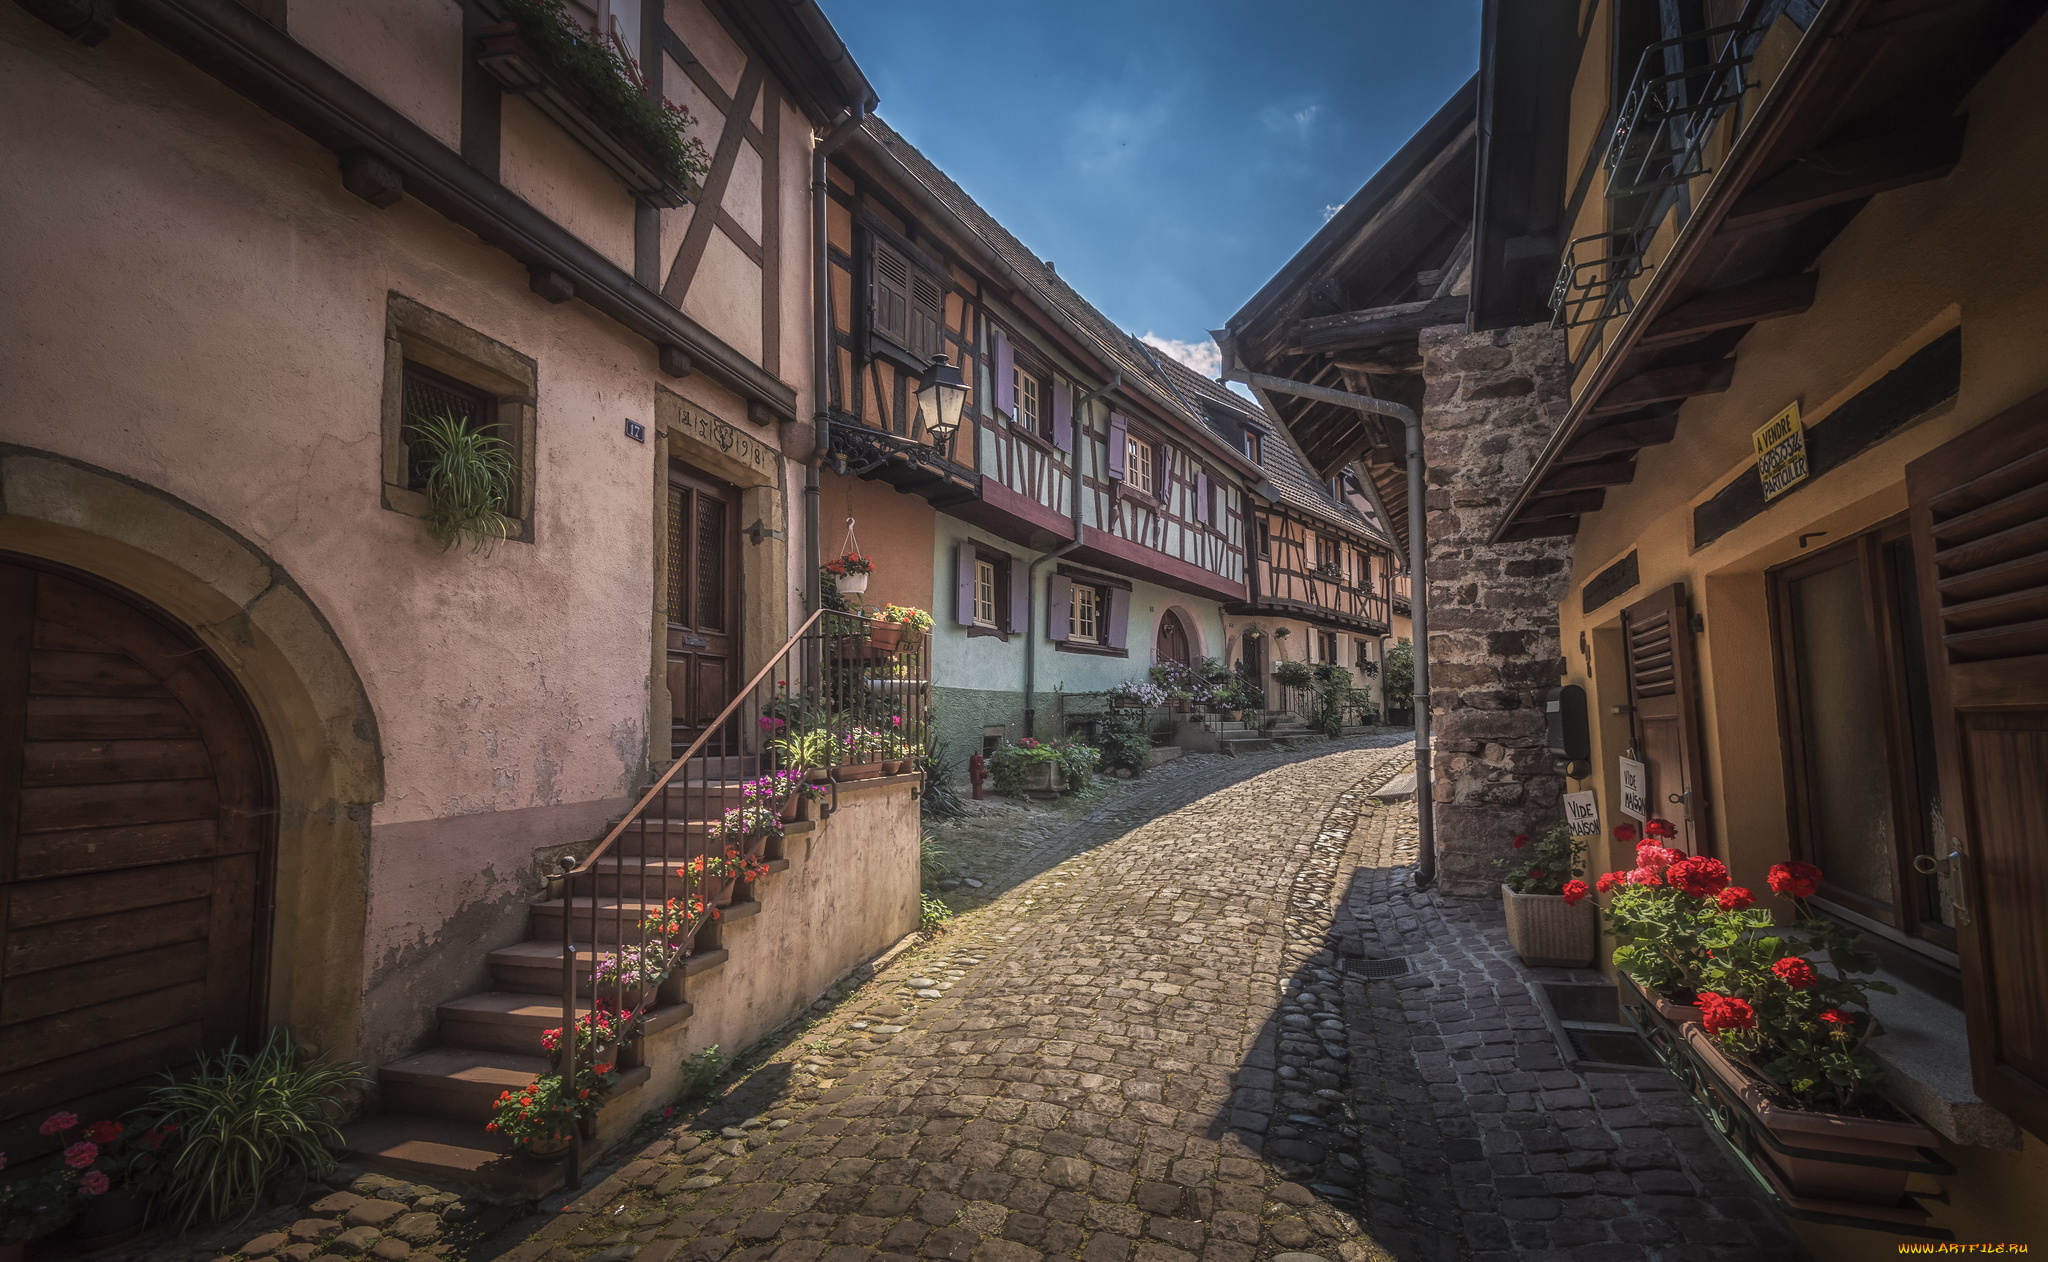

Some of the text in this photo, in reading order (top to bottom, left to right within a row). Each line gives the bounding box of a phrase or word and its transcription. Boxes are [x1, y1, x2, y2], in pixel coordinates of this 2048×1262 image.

[630, 424, 640, 438] 17
[1757, 415, 1792, 454] A VENDRE
[1624, 770, 1637, 789] VIDE
[1568, 801, 1593, 818] VIDE
[1625, 792, 1645, 816] MAISON
[1569, 820, 1600, 836] MAISON
